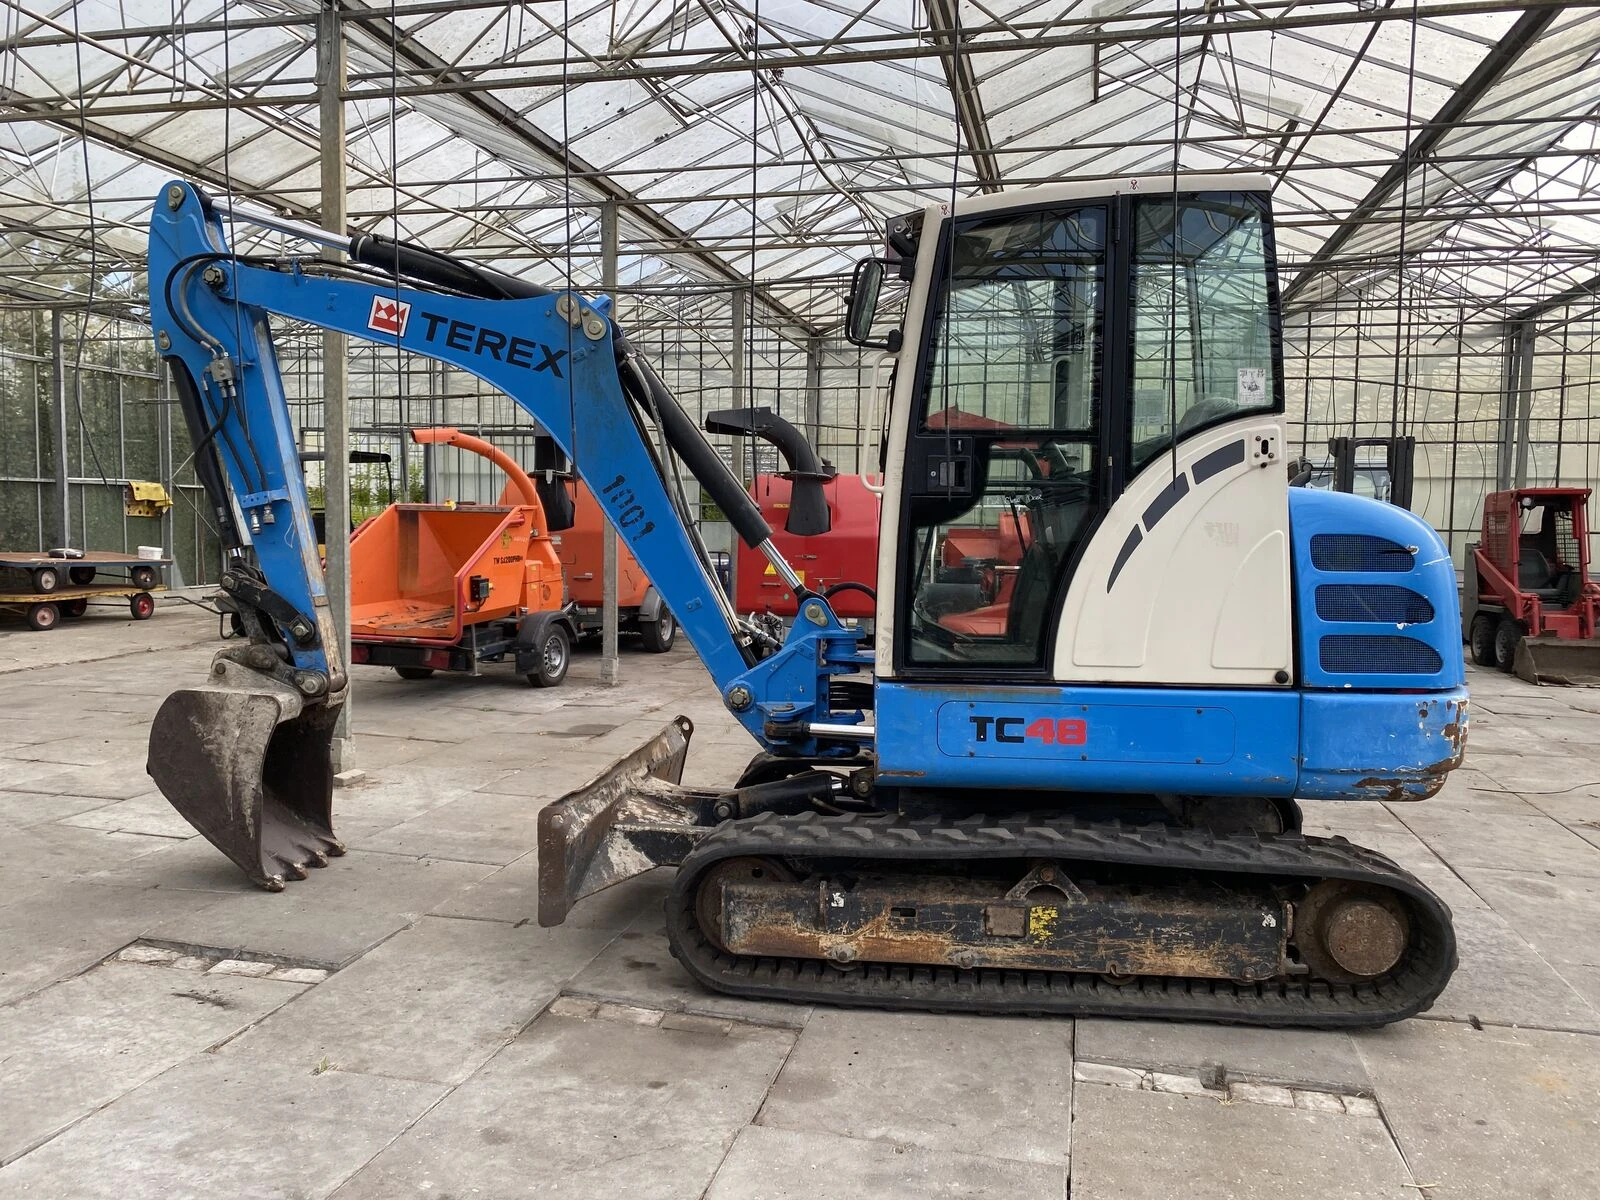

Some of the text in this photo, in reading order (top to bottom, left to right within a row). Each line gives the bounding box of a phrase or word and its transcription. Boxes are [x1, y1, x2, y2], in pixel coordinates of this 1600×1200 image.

[421, 311, 568, 379] TEREX
[602, 474, 656, 542] 1001
[969, 716, 1087, 746] TC48
